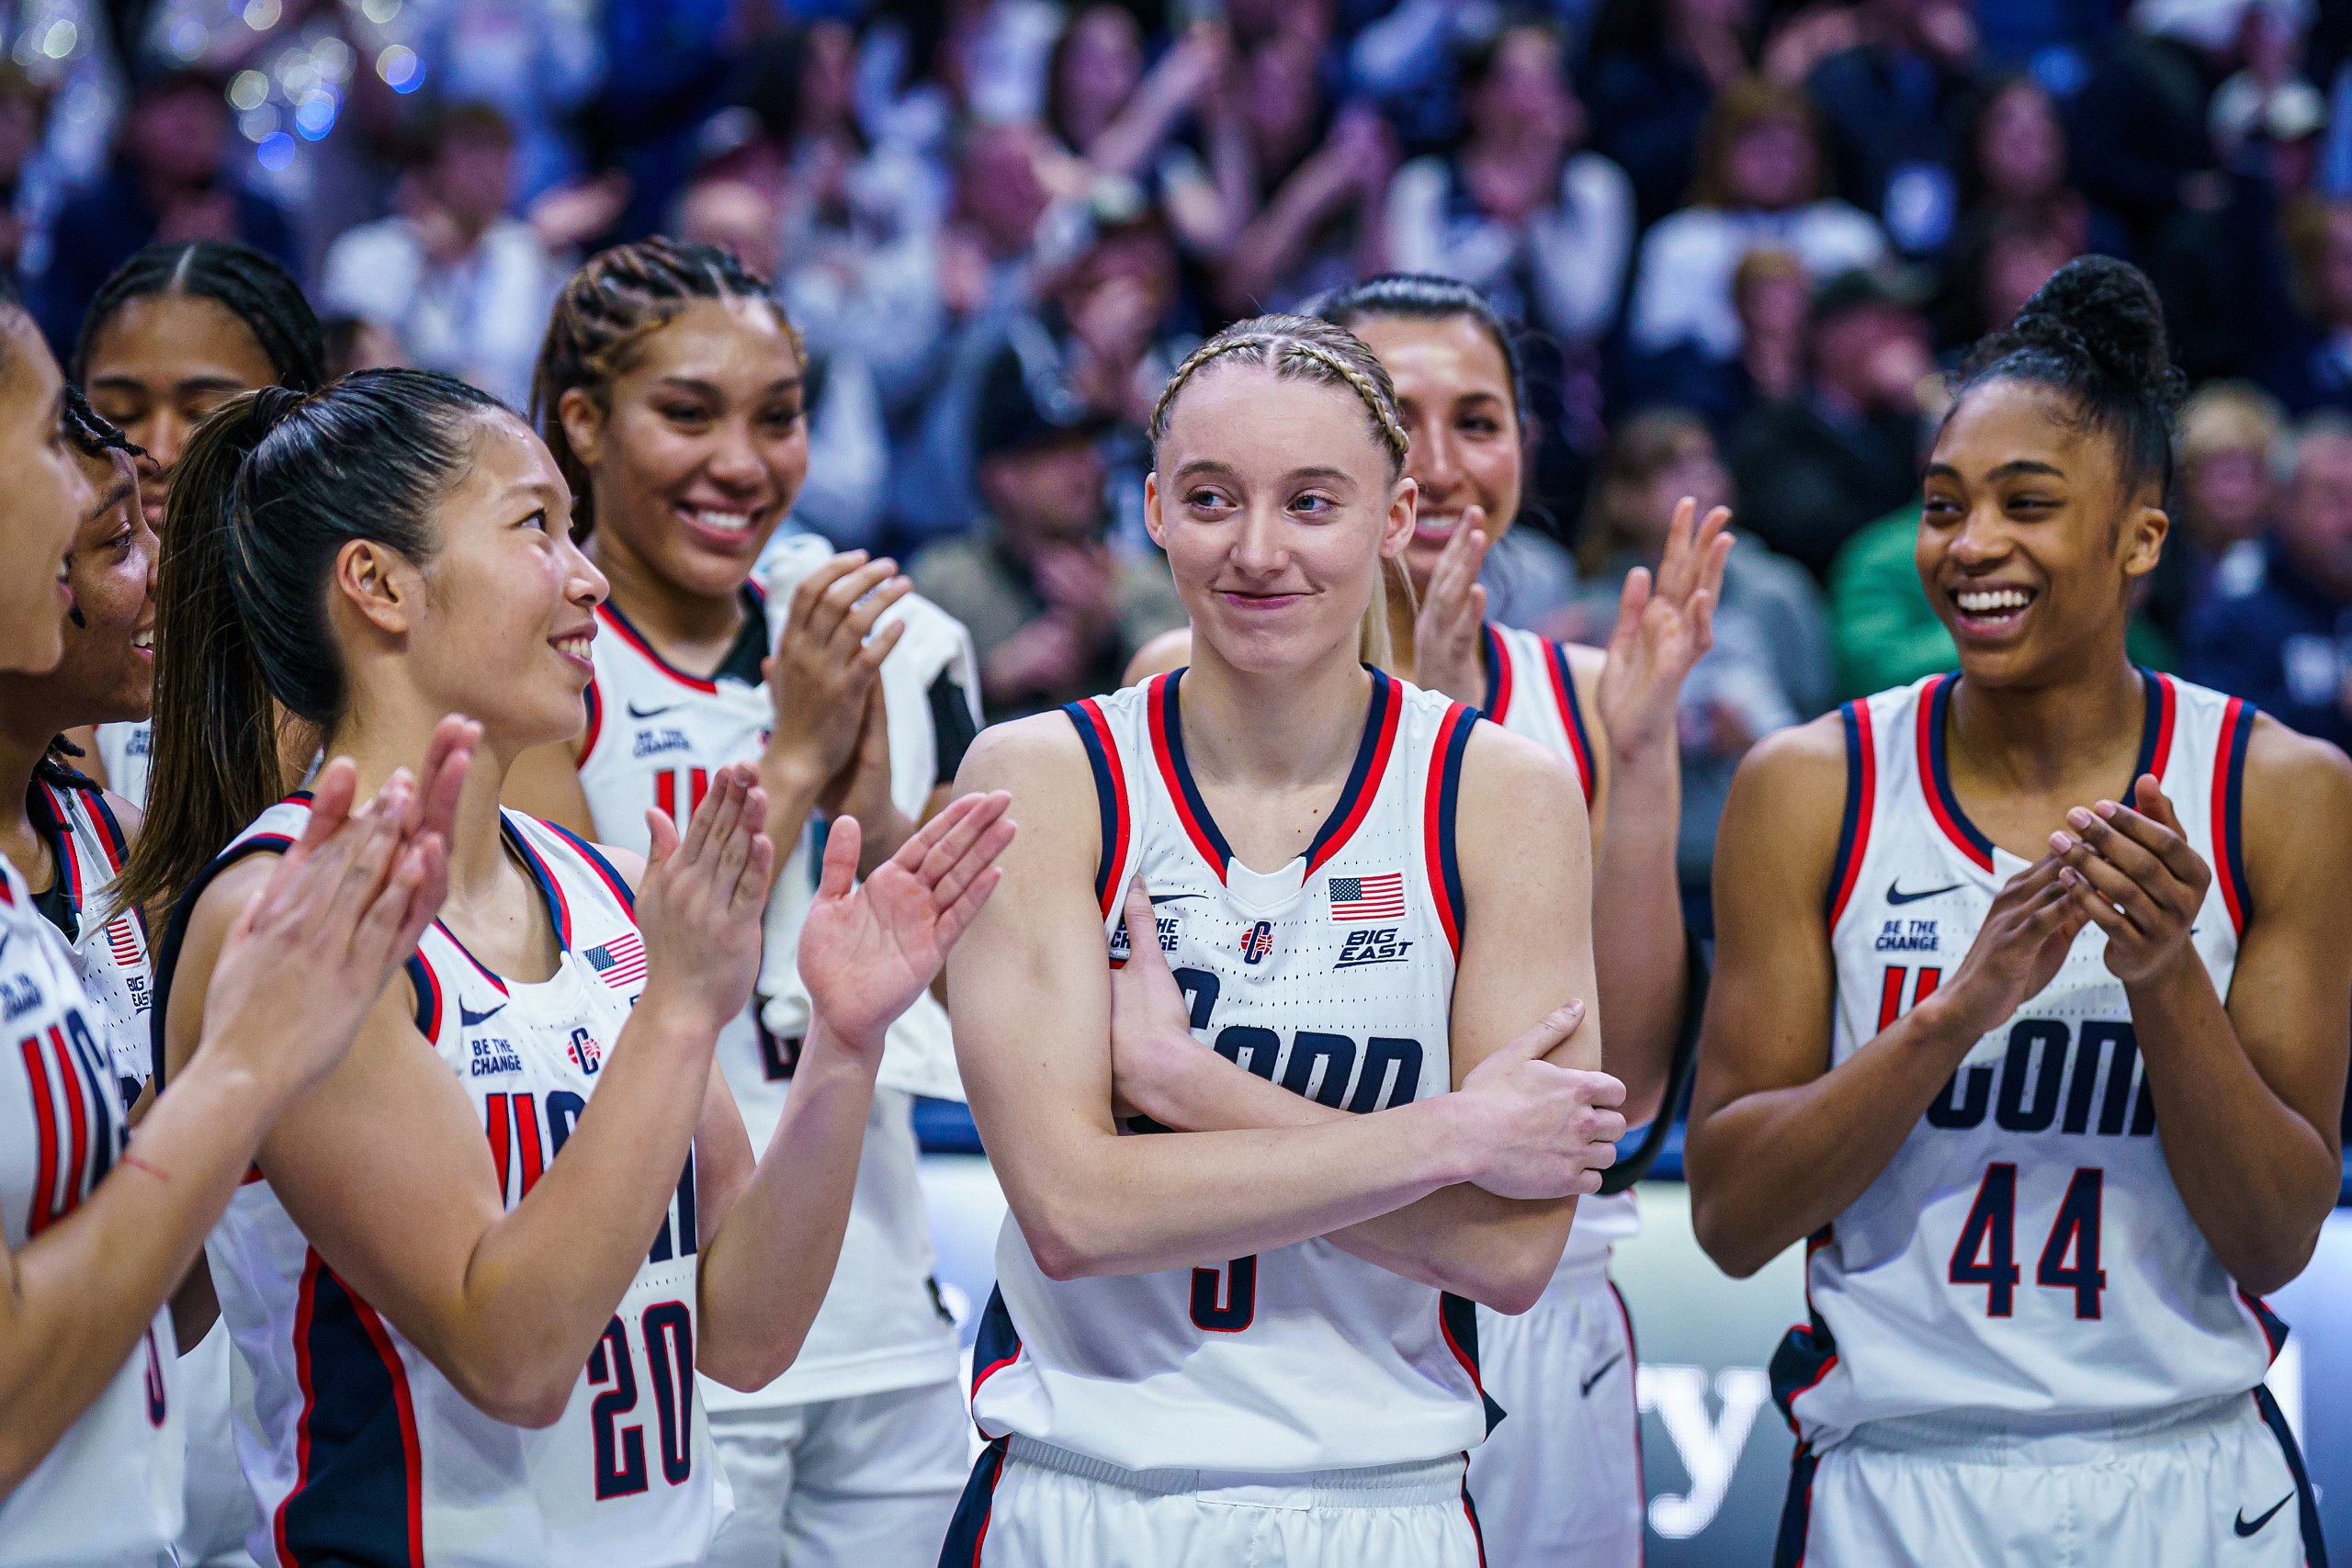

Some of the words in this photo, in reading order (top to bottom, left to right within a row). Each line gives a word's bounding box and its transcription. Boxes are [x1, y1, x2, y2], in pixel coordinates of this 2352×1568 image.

[1155, 918, 1180, 934] HE
[1883, 919, 1902, 933] BE
[1910, 919, 1938, 934] THE
[1111, 931, 1180, 952] CHGE
[1345, 928, 1399, 946] BIG
[1875, 936, 1939, 952] CHANGE
[1338, 942, 1414, 962] EAST
[126, 975, 144, 992] BIG
[471, 1039, 491, 1056] BE
[491, 1037, 514, 1055] THE
[471, 1055, 522, 1077] CHANGE
[1948, 1161, 2108, 1321] 44
[585, 1300, 694, 1502] 20
